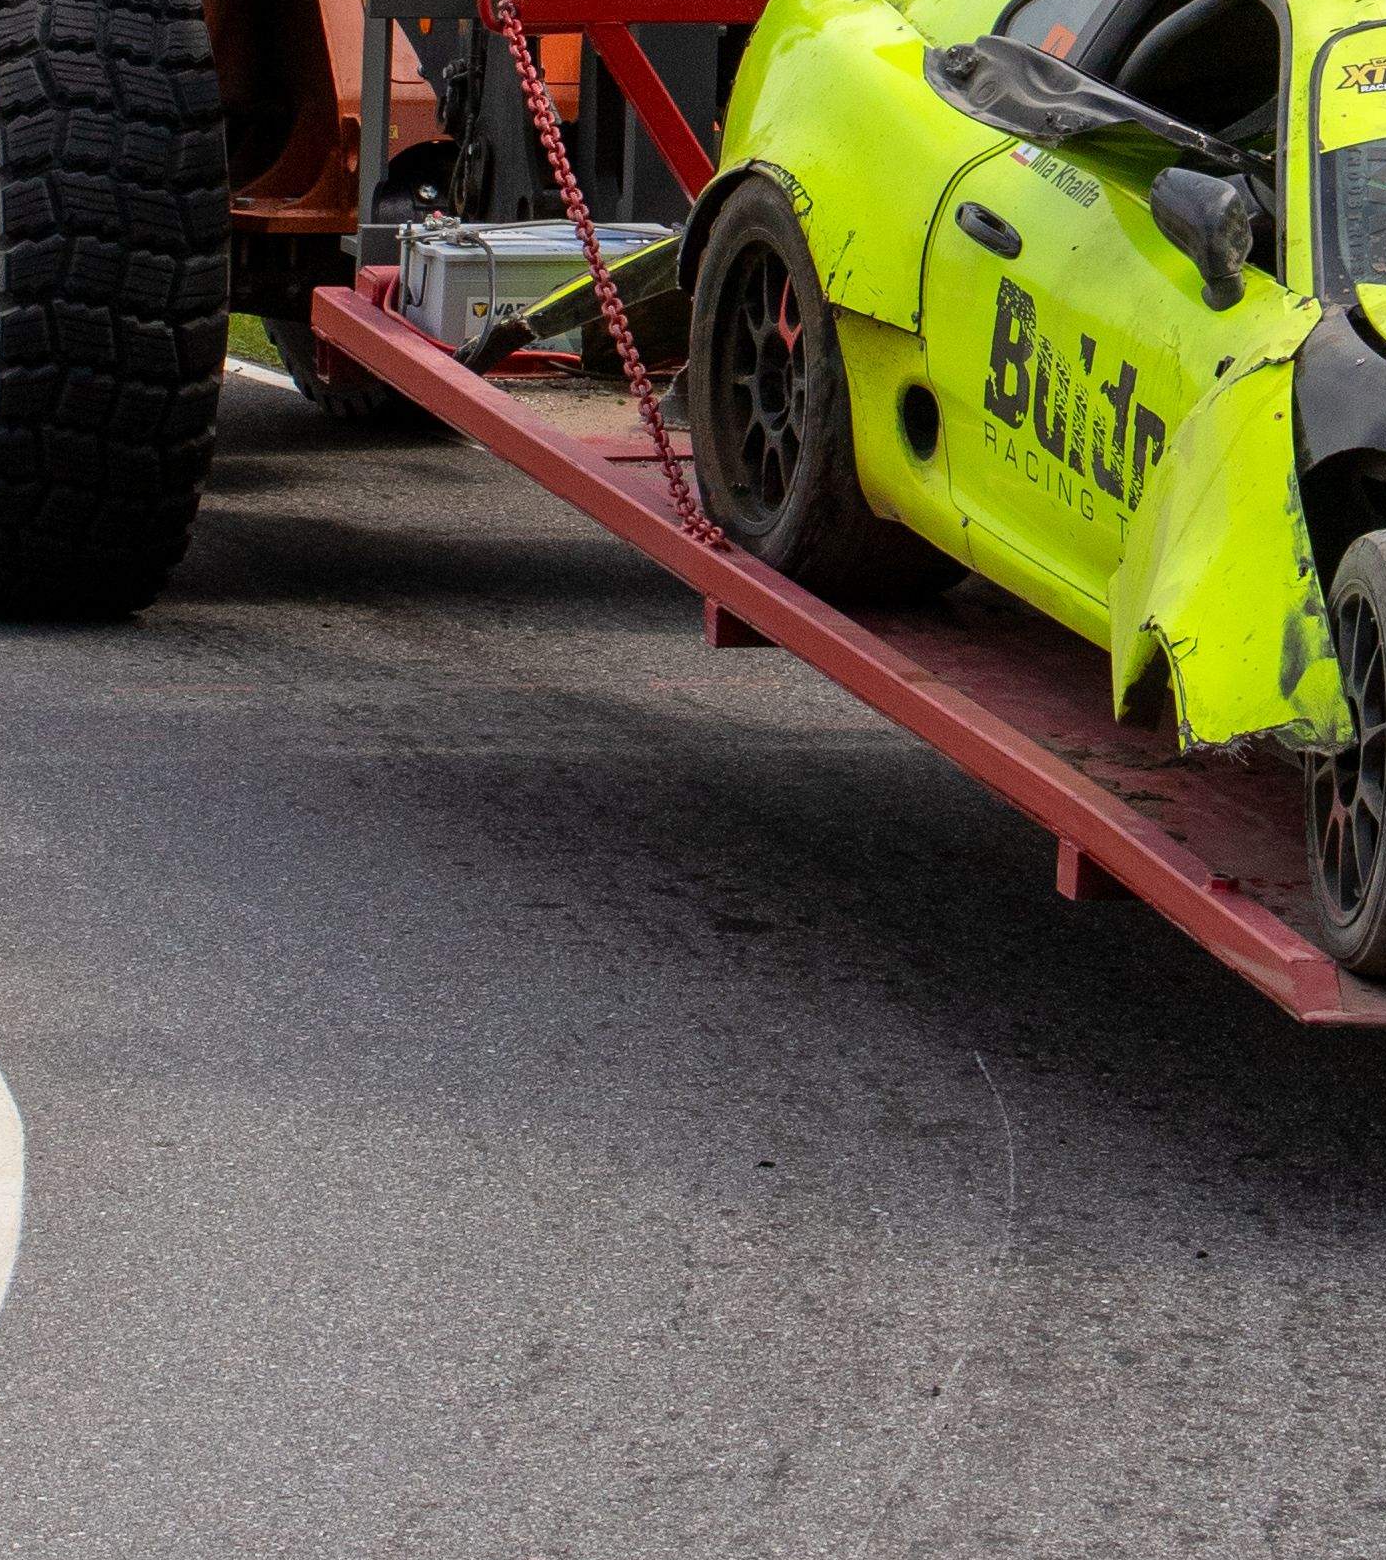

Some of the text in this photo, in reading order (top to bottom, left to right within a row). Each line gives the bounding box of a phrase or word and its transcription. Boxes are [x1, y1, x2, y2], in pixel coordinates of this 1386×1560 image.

[1028, 150, 1100, 209] Mia Khalifa
[984, 420, 1095, 522] RACING
